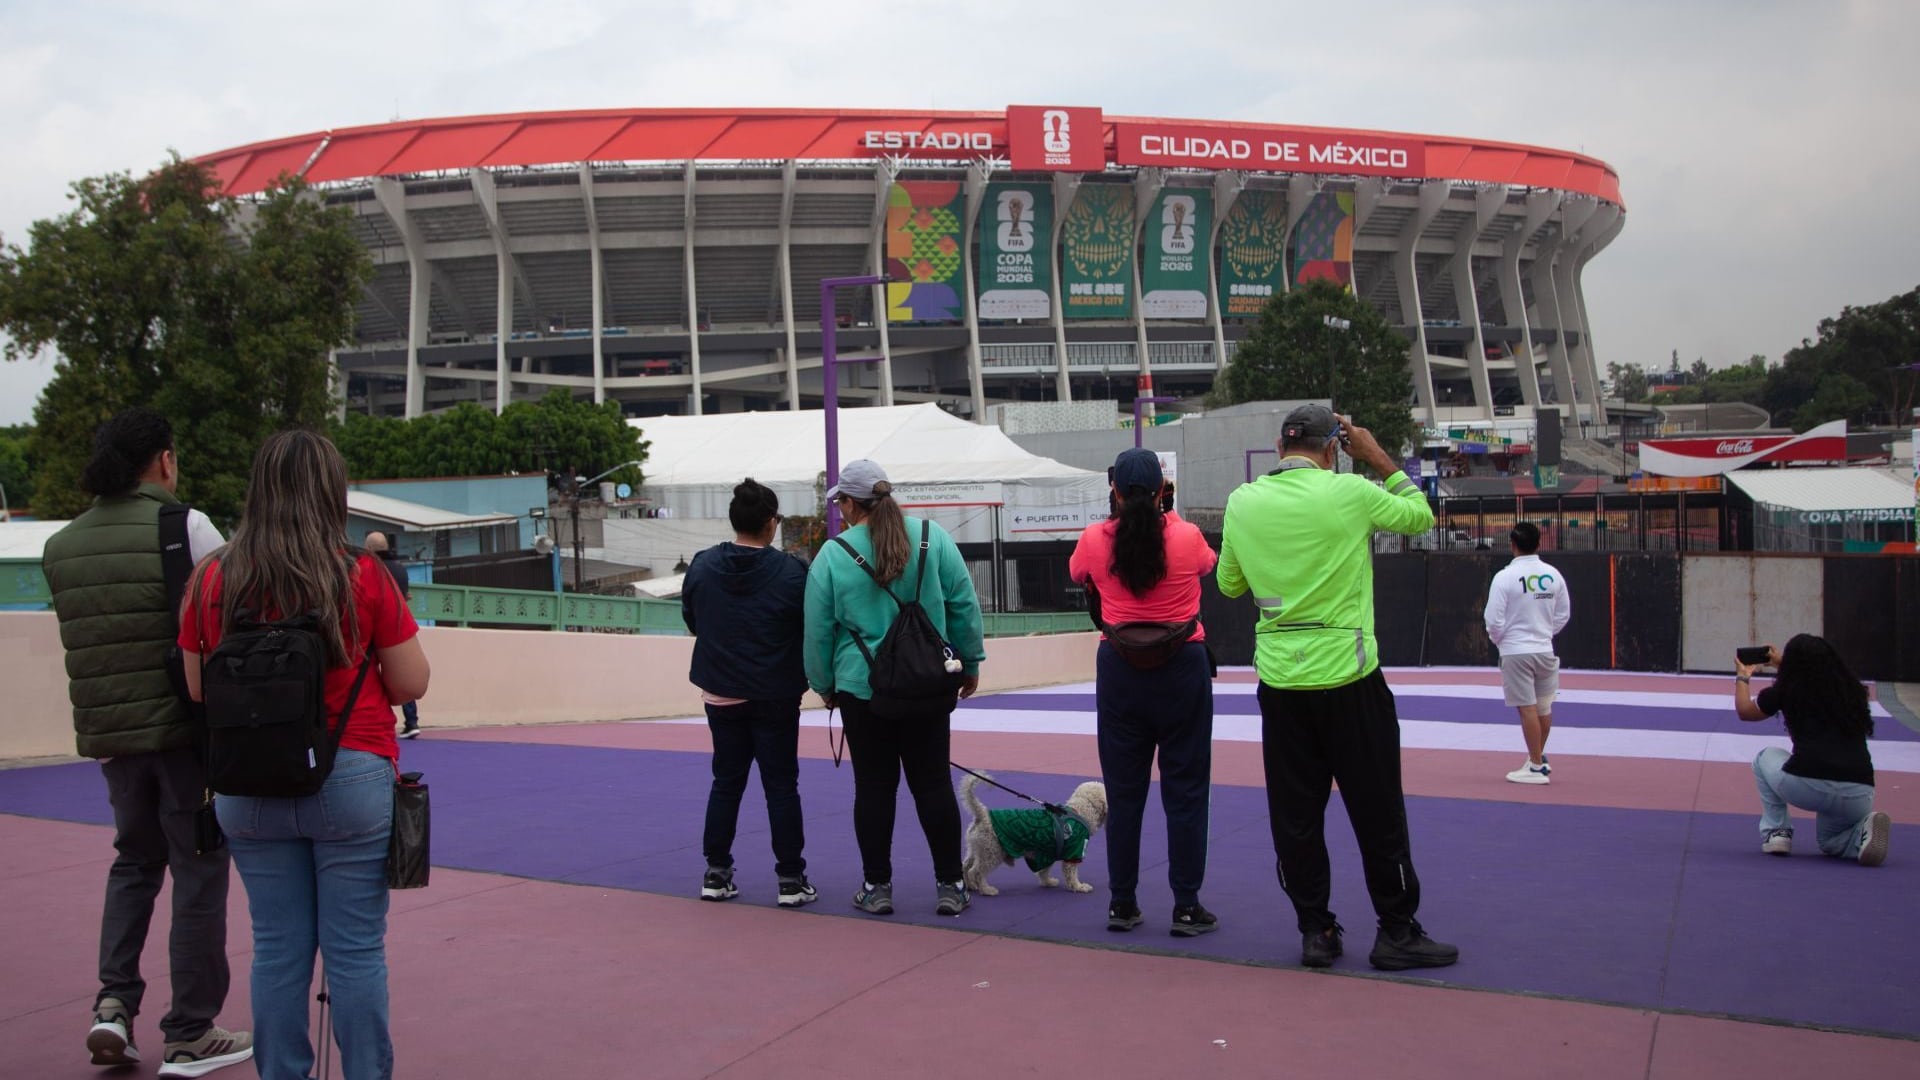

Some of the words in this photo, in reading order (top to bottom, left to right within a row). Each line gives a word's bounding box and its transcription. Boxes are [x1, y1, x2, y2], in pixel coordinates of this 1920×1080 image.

[865, 131, 992, 149] ESTADIO
[1140, 135, 1250, 159] CIUDAD
[1263, 142, 1299, 161] DE
[1309, 141, 1407, 168] MÉXICO
[1007, 239, 1025, 247] FIFA
[1170, 241, 1186, 249] FIFA
[997, 254, 1033, 265] COPA
[1160, 262, 1193, 272] 2026
[997, 274, 1033, 283] 2026
[1070, 283, 1093, 295] WE
[1095, 283, 1124, 295] ARE
[1230, 284, 1272, 296] SOMOS
[1104, 296, 1124, 305] CITY
[1716, 441, 1753, 454] Coca-Cola
[914, 484, 985, 492] ESTACIONAMIENTO
[934, 493, 961, 501] OFICIAL
[1027, 515, 1069, 523] PUERTA
[1800, 512, 1842, 524] COPA
[1845, 508, 1914, 522] MUNDIAL
